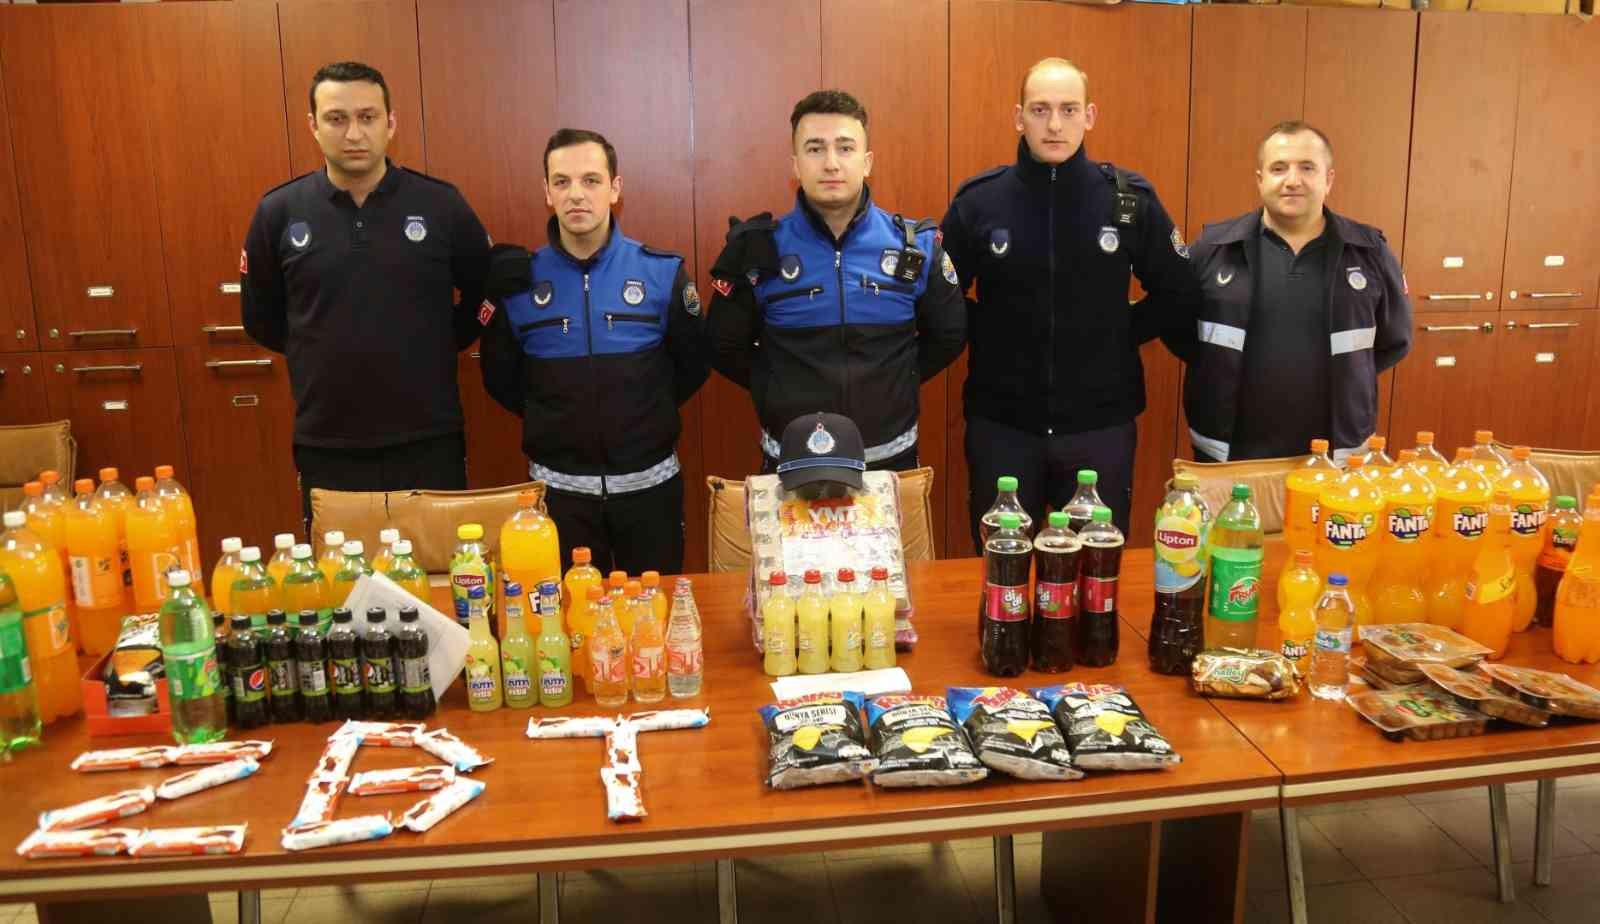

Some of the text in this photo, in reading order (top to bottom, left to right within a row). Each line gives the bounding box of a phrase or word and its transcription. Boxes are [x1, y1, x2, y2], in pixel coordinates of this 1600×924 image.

[1325, 519, 1367, 540] FANTA
[1388, 514, 1429, 533] FANTA
[1453, 511, 1488, 531] FANT
[1159, 531, 1195, 546] Lipton
[455, 575, 482, 586] Lipton
